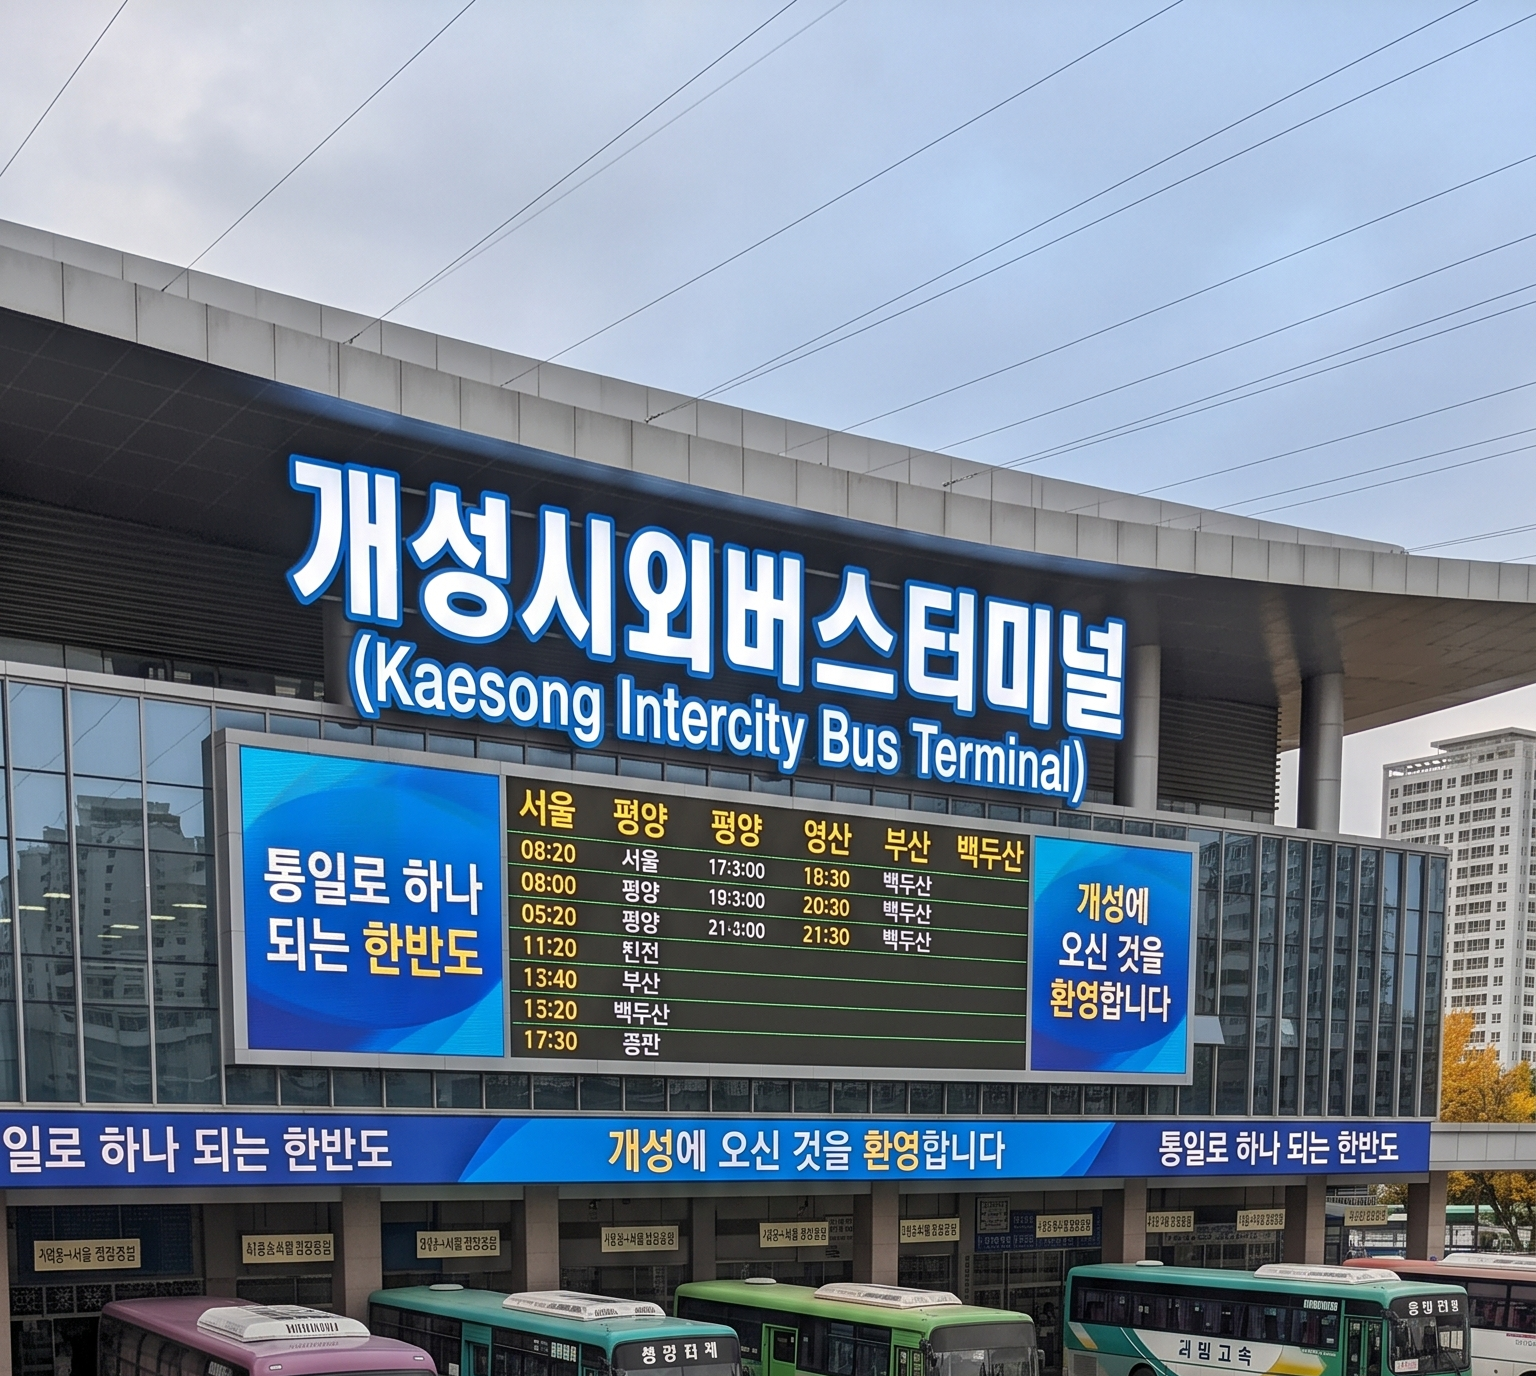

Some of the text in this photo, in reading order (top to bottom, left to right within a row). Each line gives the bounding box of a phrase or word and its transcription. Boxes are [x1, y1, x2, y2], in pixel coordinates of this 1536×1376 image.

[289, 456, 1128, 737] 개성시외버스터미널
[352, 634, 1089, 804] (Kaesong Intercity Bus Terminal)
[519, 789, 1025, 874] 서울 평양 평양 영산 부산 백두산
[264, 847, 483, 916] 통일로 하나
[521, 838, 577, 864] 08:20
[621, 848, 660, 874] 서울
[804, 866, 850, 888] 18:30
[883, 871, 933, 897] 백두산
[521, 870, 577, 895] 08:00
[803, 895, 850, 917] 20:30
[883, 900, 933, 925] 백두산
[1077, 882, 1149, 926] 개성에
[266, 916, 483, 978] 되는 한반도
[521, 903, 577, 927] 05:20
[802, 925, 850, 946] 21:30
[882, 928, 932, 953] 백두산
[523, 935, 577, 958] 11:20
[1058, 931, 1164, 975] 오신 것을
[524, 967, 661, 995] 13:40 부산
[1050, 978, 1172, 1023] 환영합니다
[614, 1001, 671, 1026] 백두산
[524, 1029, 578, 1051] 17:30
[2, 1125, 393, 1173] 일로 하나 되는 한반도
[608, 1128, 1006, 1173] 개성에 오신 것을 환영합니다
[1158, 1130, 1399, 1167] 통일로 하나 되는 한반도
